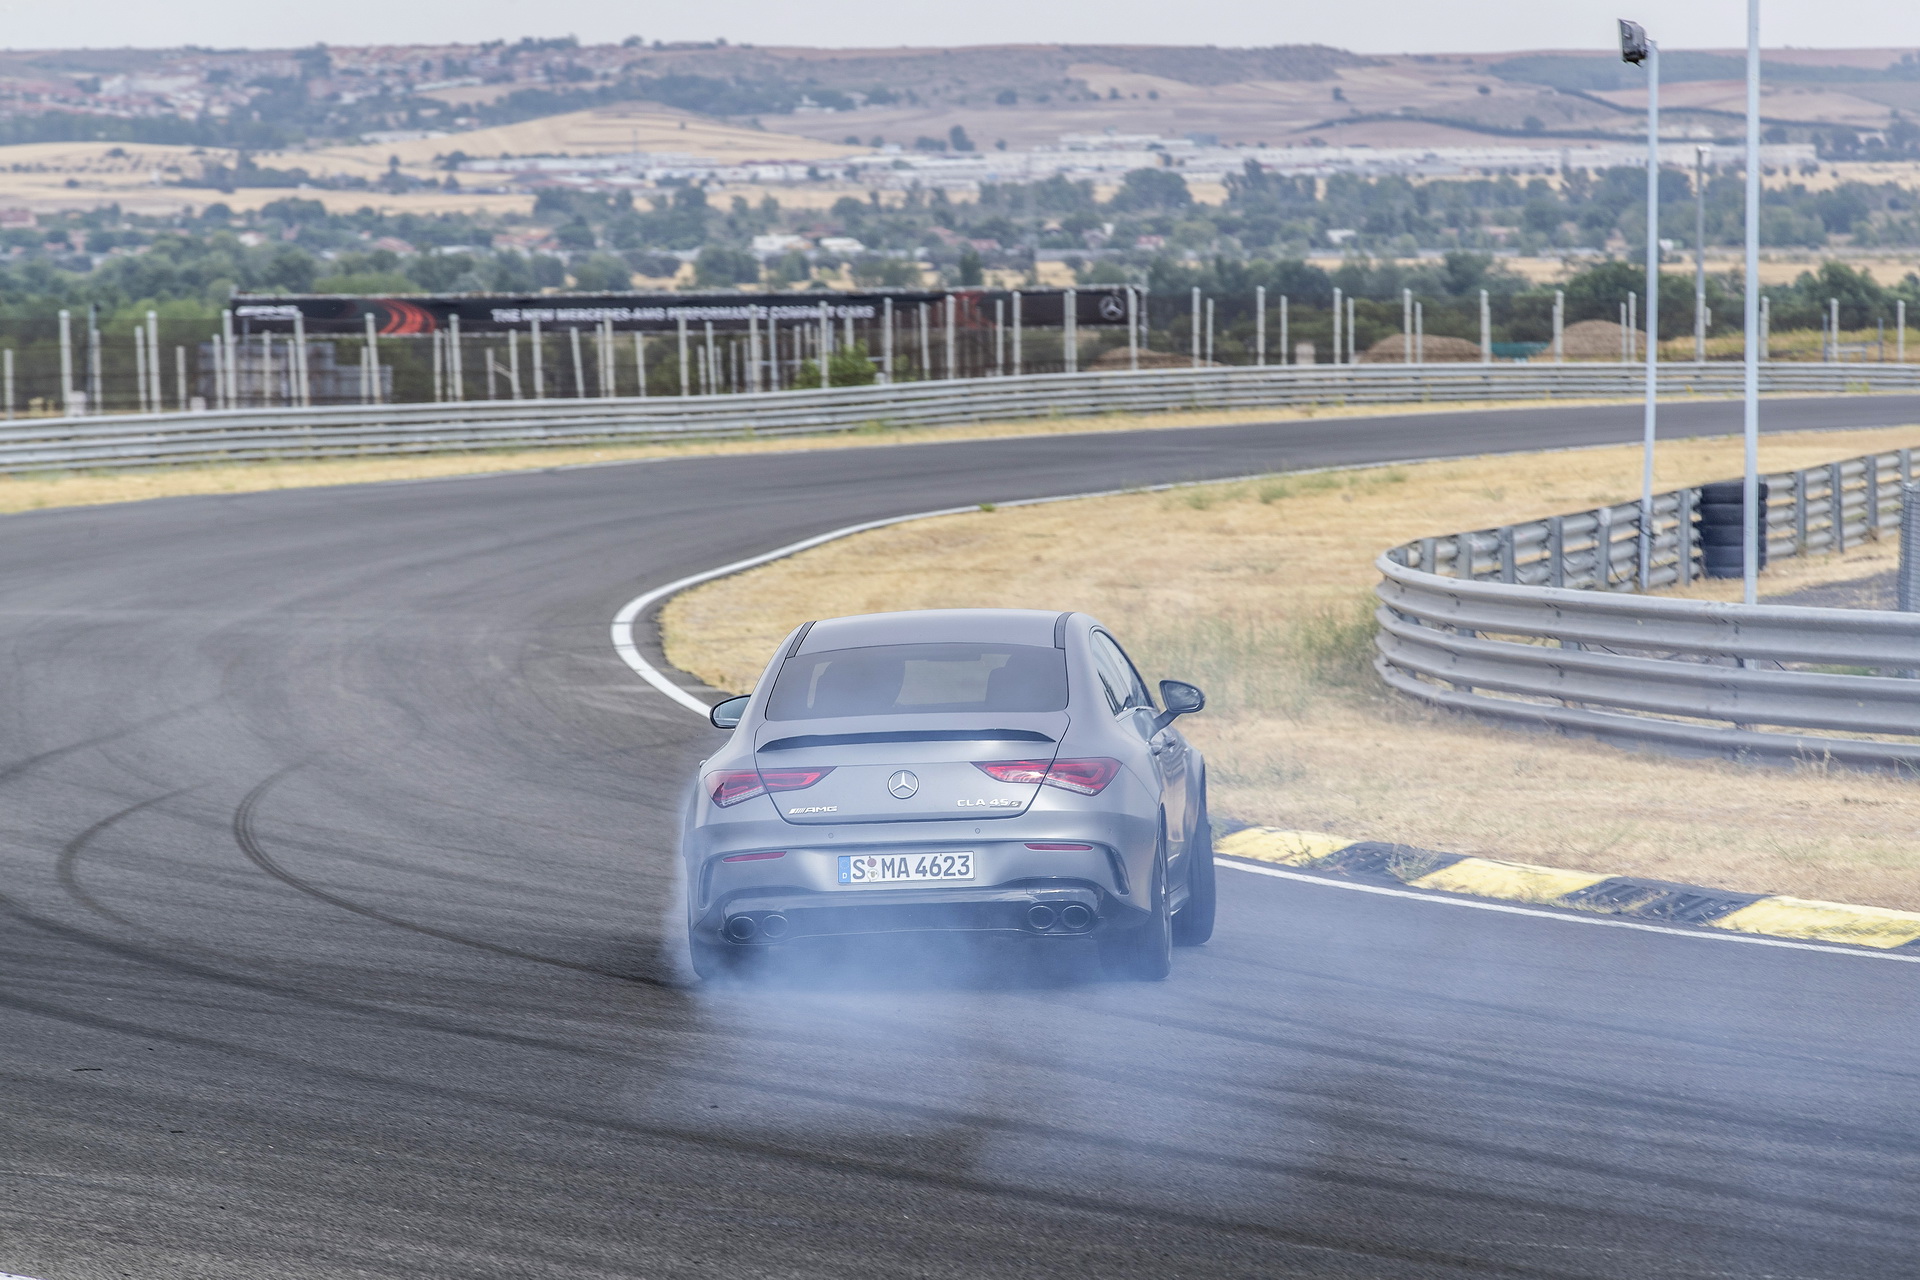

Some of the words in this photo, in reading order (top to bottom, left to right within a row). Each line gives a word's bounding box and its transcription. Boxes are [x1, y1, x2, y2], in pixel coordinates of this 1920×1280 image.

[666, 306, 768, 320] PERFORMANE
[769, 305, 835, 319] COMPAT
[957, 798, 986, 807] CLA
[915, 855, 970, 877] 4623
